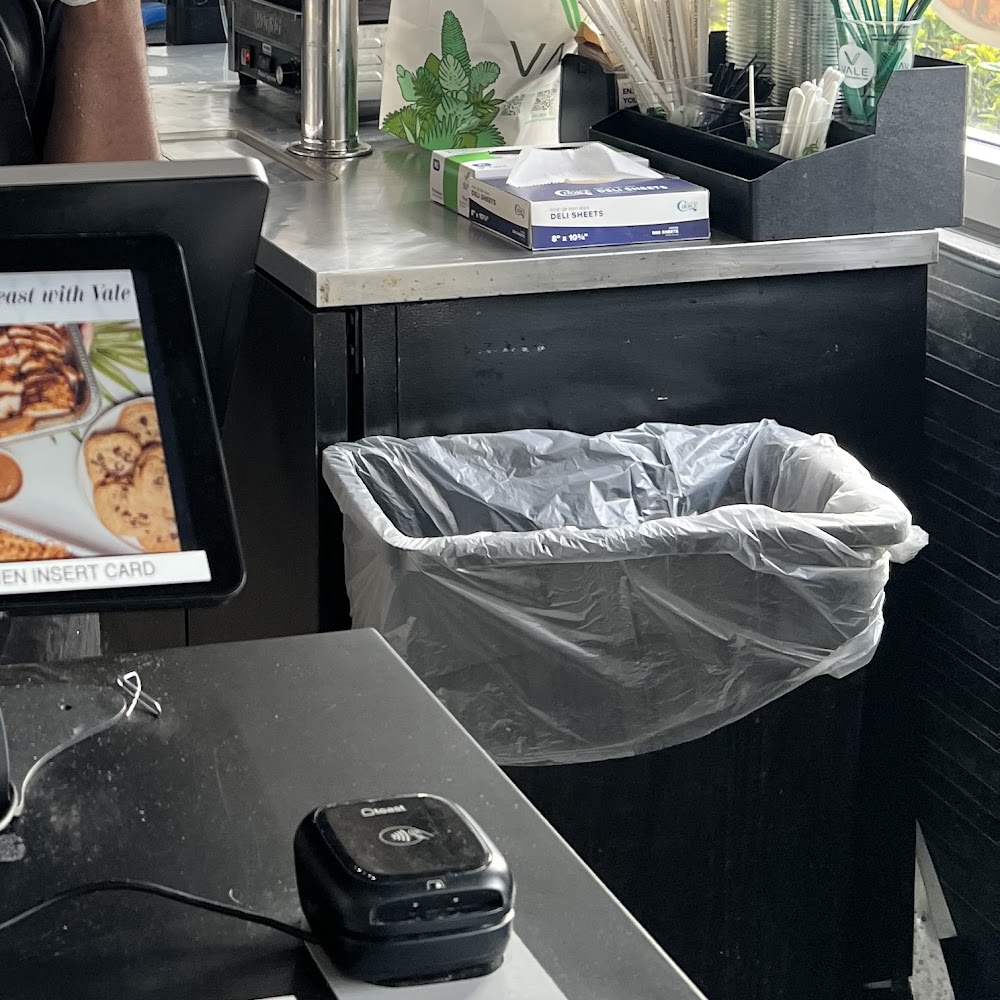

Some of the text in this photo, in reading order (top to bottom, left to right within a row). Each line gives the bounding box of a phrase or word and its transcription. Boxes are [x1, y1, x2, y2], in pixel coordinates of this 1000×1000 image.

[510, 40, 565, 78] VA
[841, 65, 868, 77] VALE
[624, 184, 668, 192] SHEETS
[471, 190, 480, 200] DELI
[480, 192, 496, 206] SHEETS
[550, 210, 604, 220] DELI SHEETS
[42, 284, 85, 304] with
[92, 284, 131, 302] Vale
[32, 564, 98, 585] INSERT
[104, 560, 156, 580] CARD
